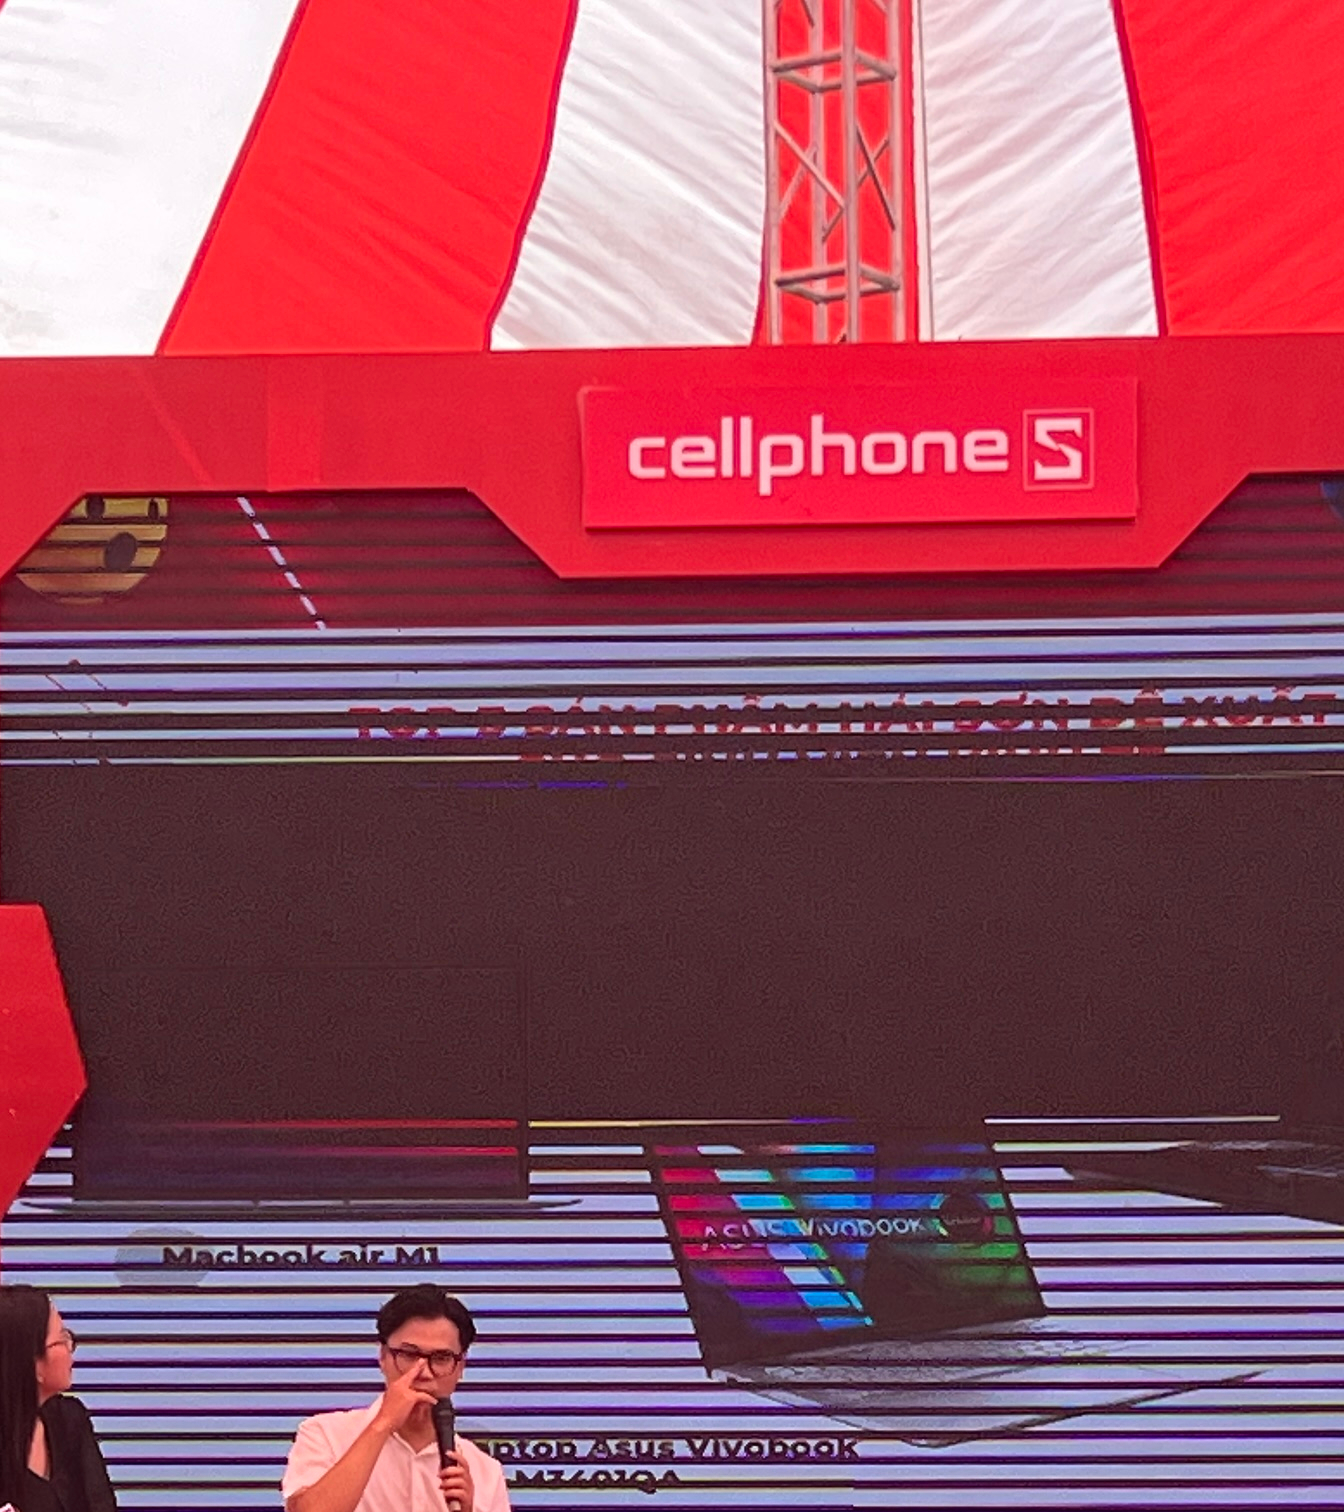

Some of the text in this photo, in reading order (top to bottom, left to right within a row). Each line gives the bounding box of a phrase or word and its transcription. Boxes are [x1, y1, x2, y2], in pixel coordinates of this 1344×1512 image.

[162, 1242, 441, 1267] Macbook air M1
[588, 1437, 675, 1461] Asus
